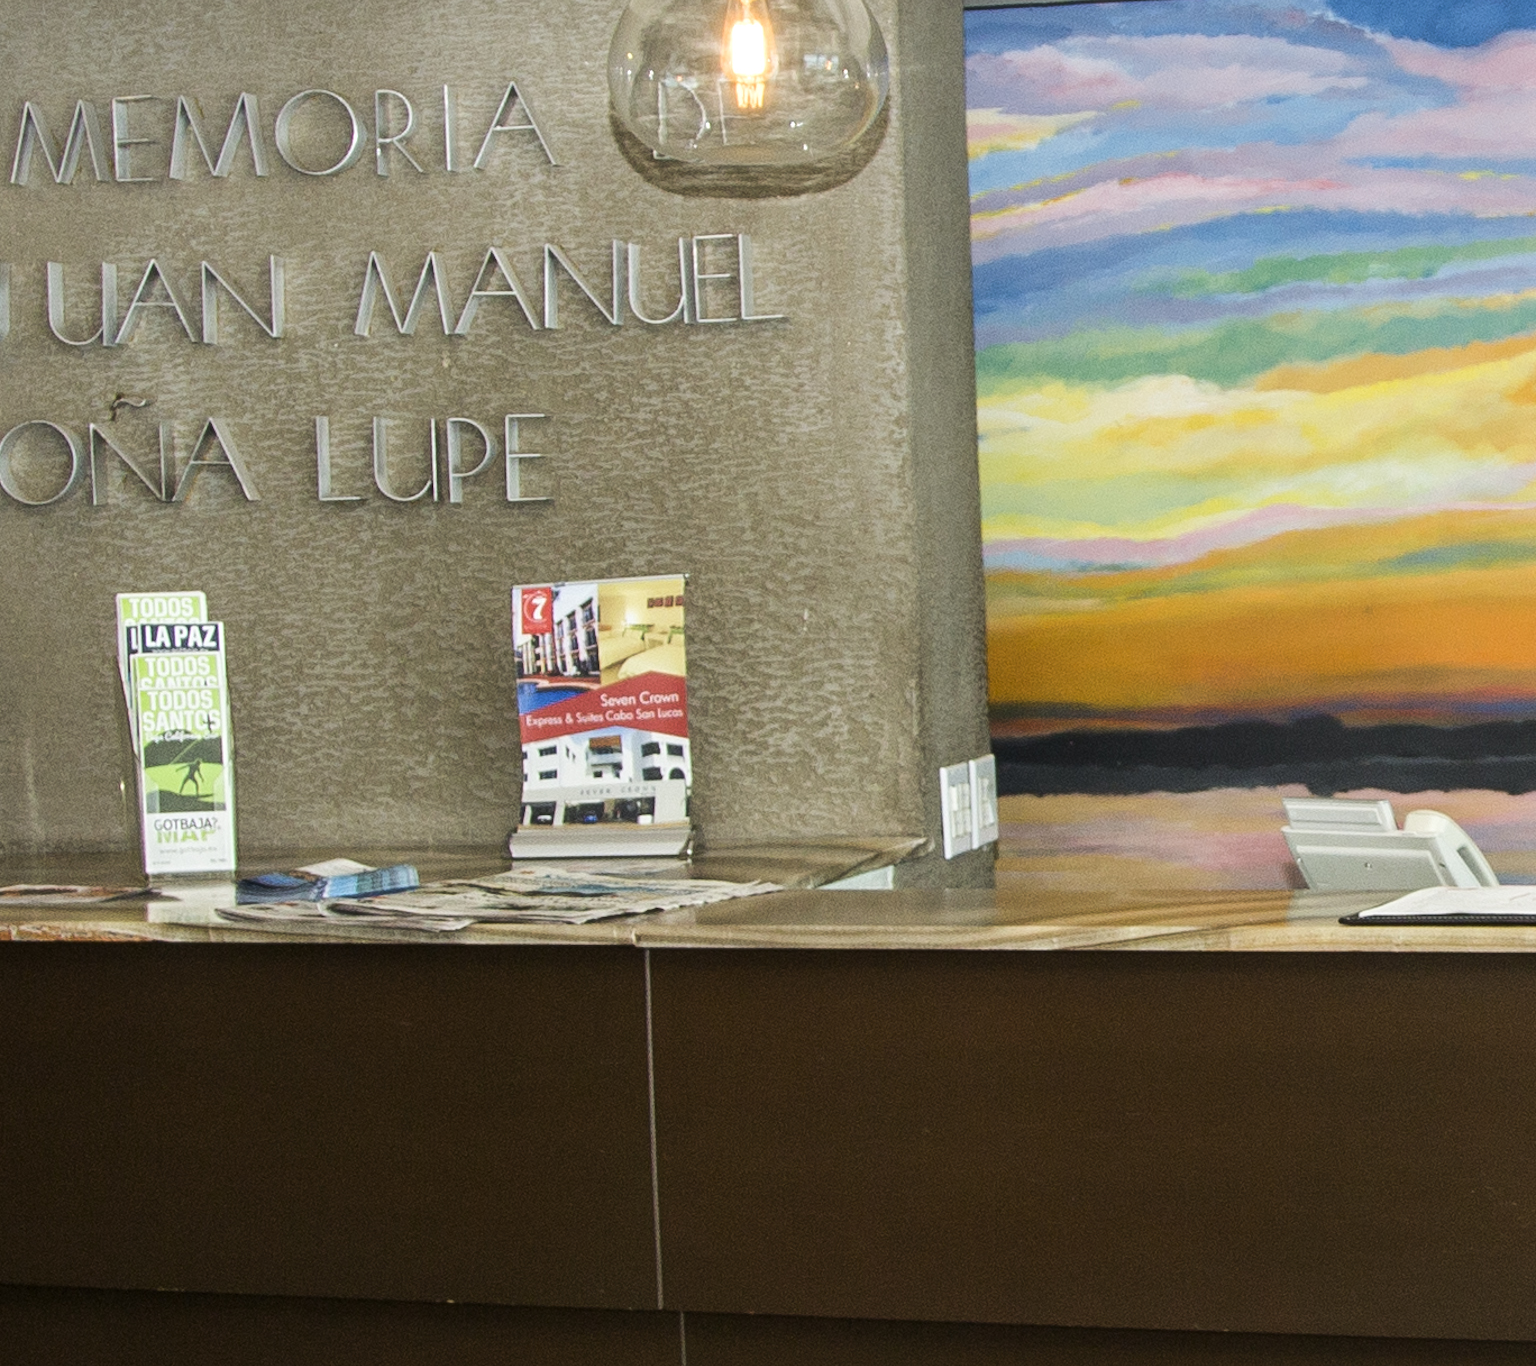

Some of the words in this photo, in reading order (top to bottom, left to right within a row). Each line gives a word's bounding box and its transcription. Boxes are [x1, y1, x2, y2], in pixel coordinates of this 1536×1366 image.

[10, 81, 560, 184] MEMORIA
[354, 233, 789, 337] MANUEL
[315, 413, 552, 503] LUPE
[128, 597, 194, 619] TODOS
[531, 597, 547, 620] 7
[145, 625, 171, 648] LA
[174, 623, 217, 647] PAZ
[145, 656, 210, 677] TODOS
[147, 689, 213, 711] TODOS
[600, 693, 636, 707] Seven
[639, 691, 679, 705] Crown
[143, 709, 221, 732] SANTOS
[526, 714, 562, 728] Express
[565, 713, 573, 723] &
[576, 711, 604, 723] Suites
[605, 710, 634, 722] Cabo
[636, 708, 656, 719] San
[657, 707, 683, 718] Lucas
[157, 829, 216, 843] MAP
